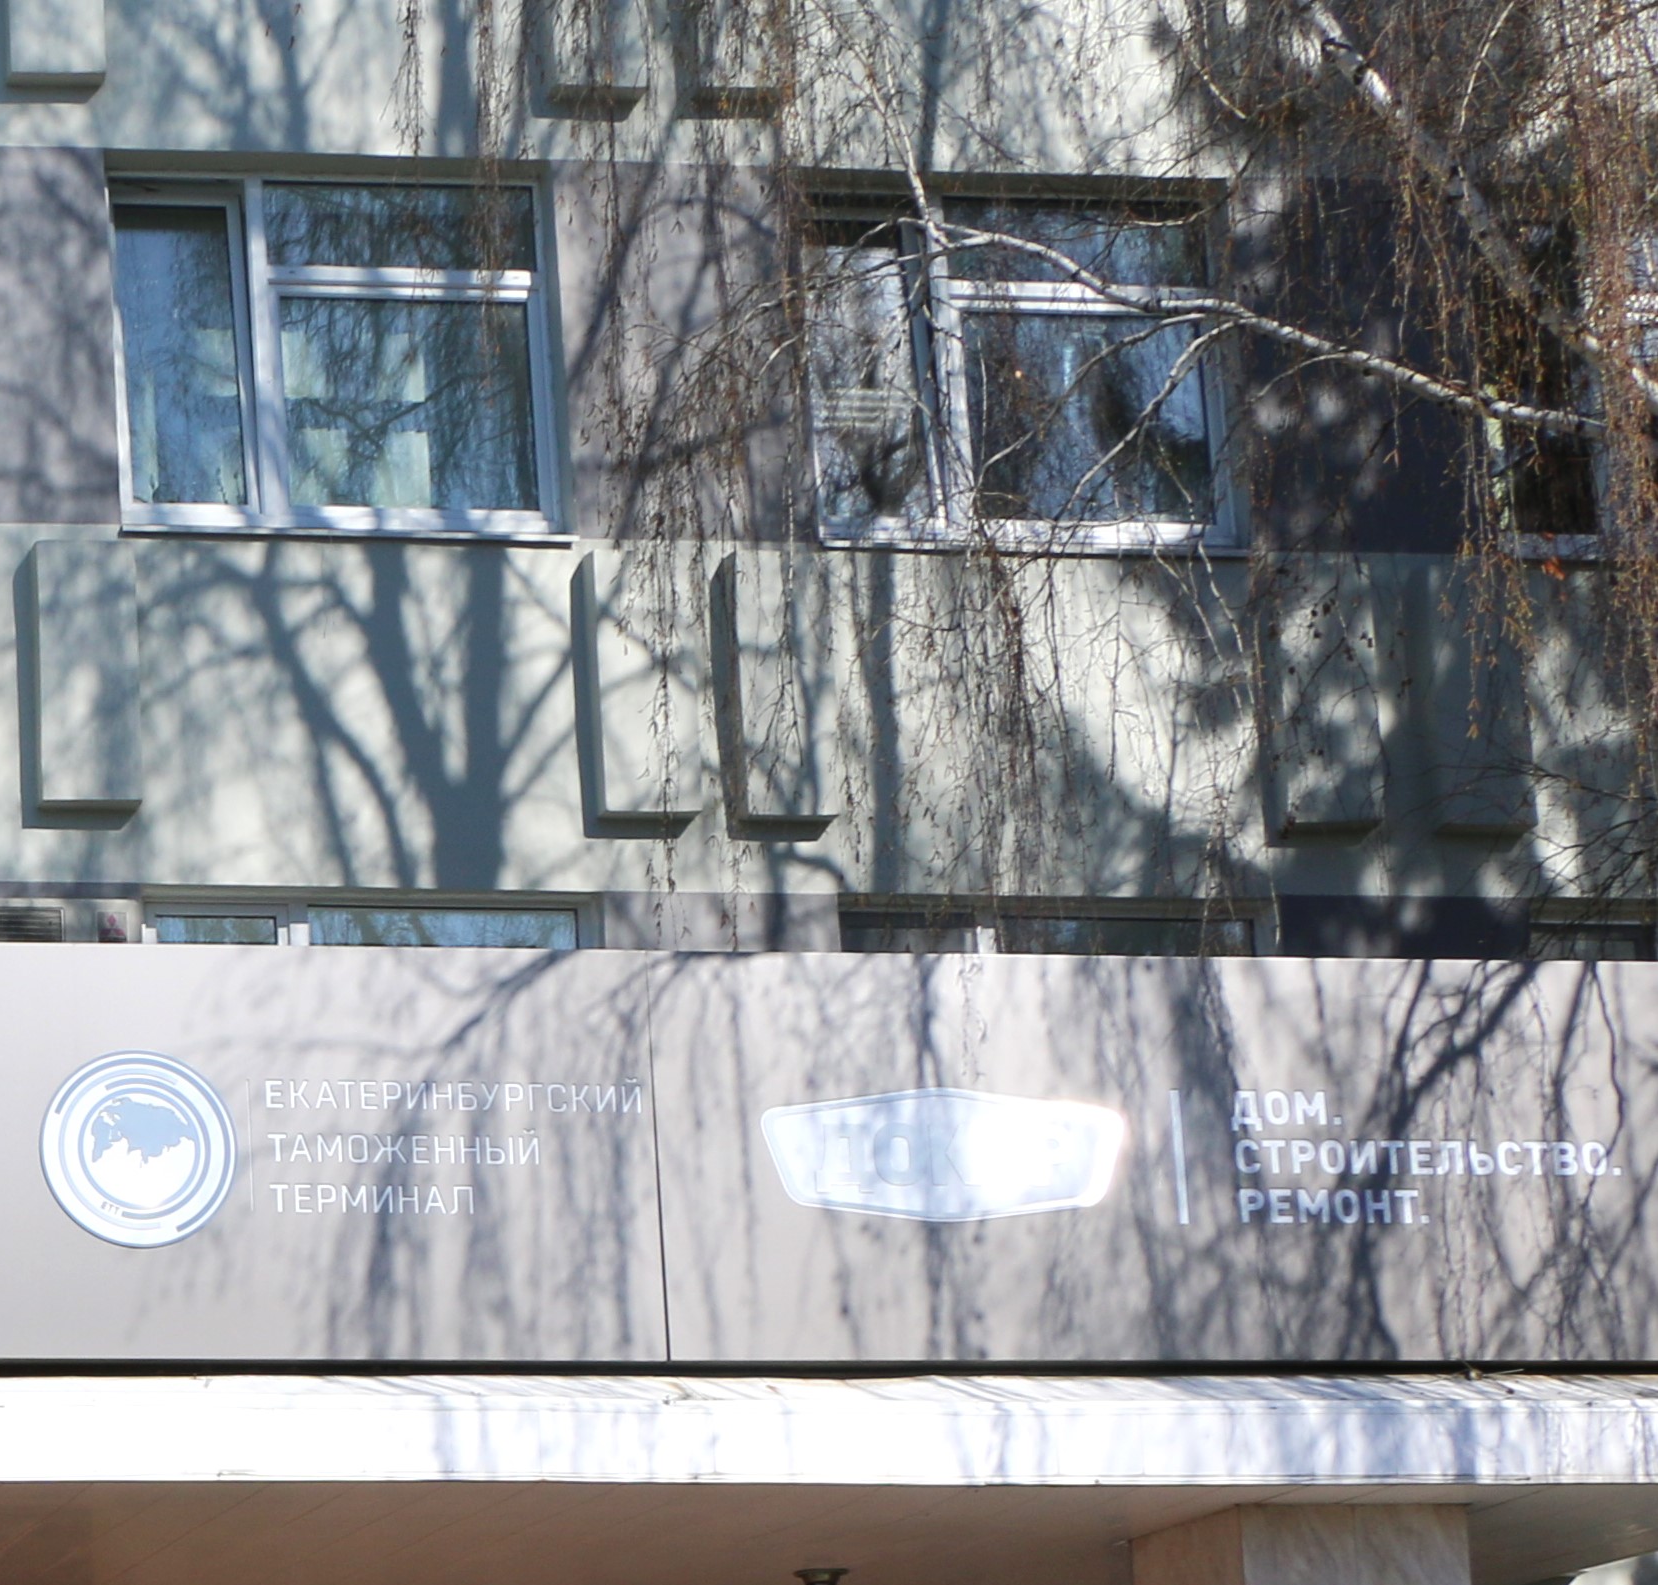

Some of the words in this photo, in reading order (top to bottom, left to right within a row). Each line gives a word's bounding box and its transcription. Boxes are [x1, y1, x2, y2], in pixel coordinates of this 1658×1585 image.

[264, 1077, 644, 1115] ЕКАТЕРИНБУРГСКИЙ
[1231, 1090, 1343, 1132] ДОМ.
[267, 1129, 542, 1166] ТАМОЖЕННЫЙ
[814, 1121, 1073, 1194] ДОКР
[1233, 1138, 1623, 1177] СТРОИТЕЛЬСТВО.
[268, 1183, 476, 1215] ТЕРМИНАЛ
[1239, 1187, 1431, 1225] РЕМОНТ.
